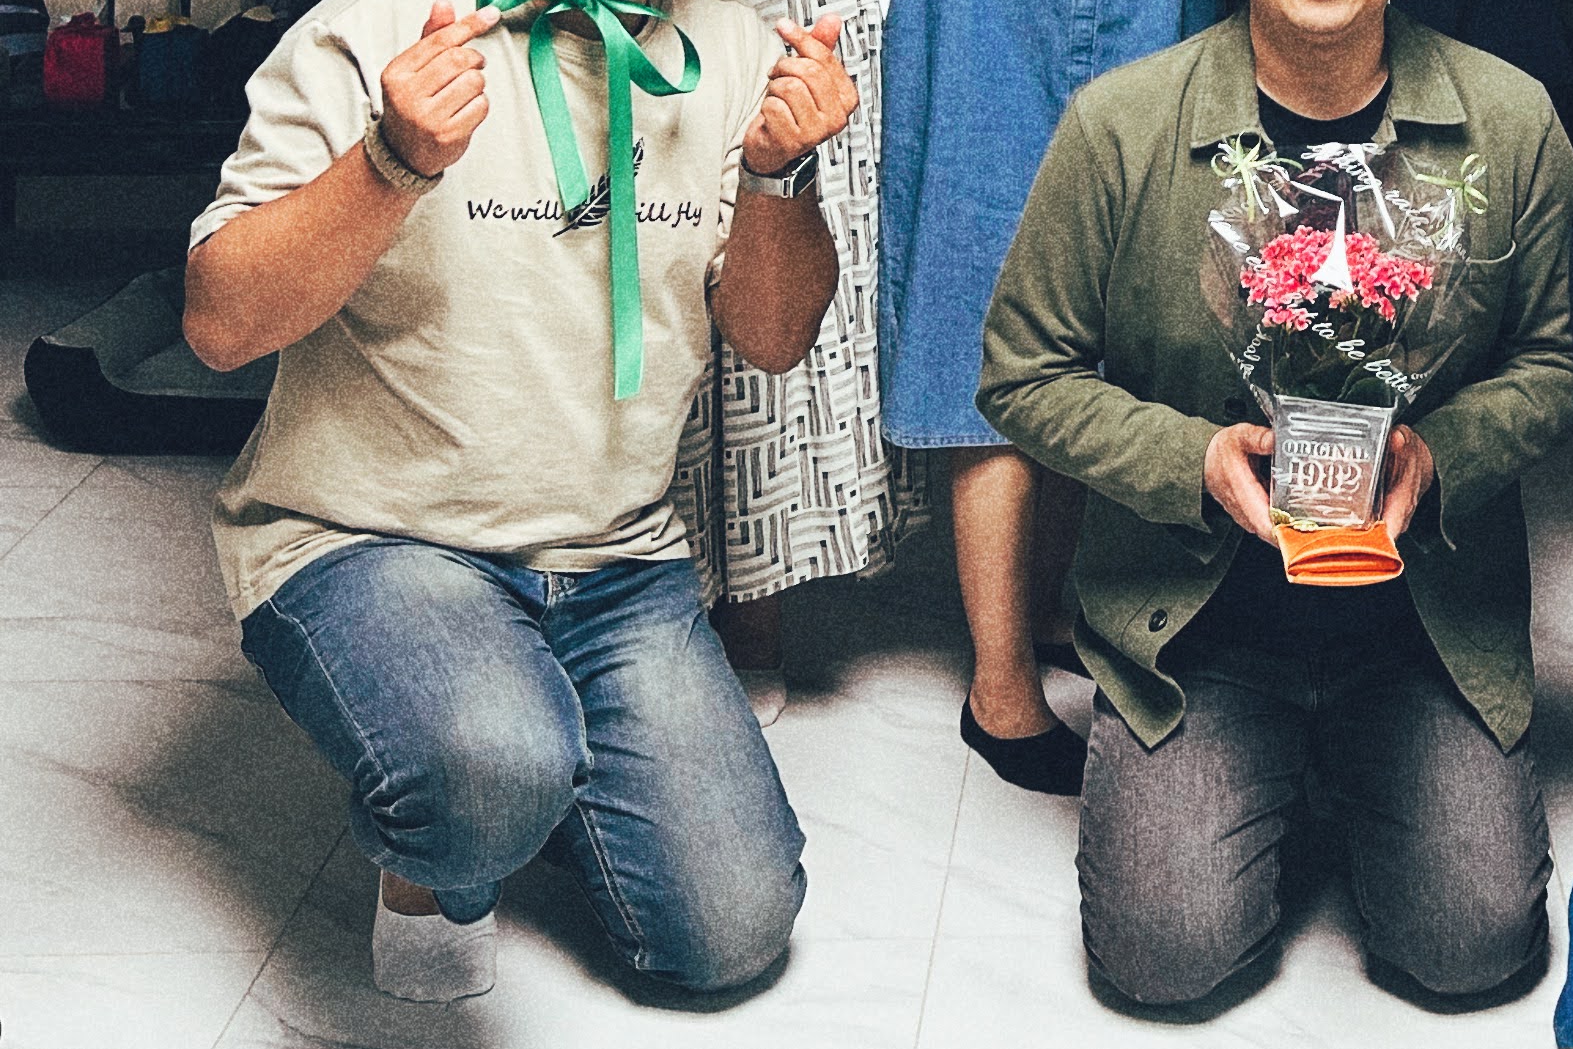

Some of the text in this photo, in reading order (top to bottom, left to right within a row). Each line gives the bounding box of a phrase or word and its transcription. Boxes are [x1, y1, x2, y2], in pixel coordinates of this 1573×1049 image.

[467, 199, 703, 228] We will ill fly
[1312, 322, 1338, 340] to
[1335, 339, 1366, 361] be
[1282, 439, 1370, 463] ORIGINAL
[1288, 457, 1362, 493] 1982
